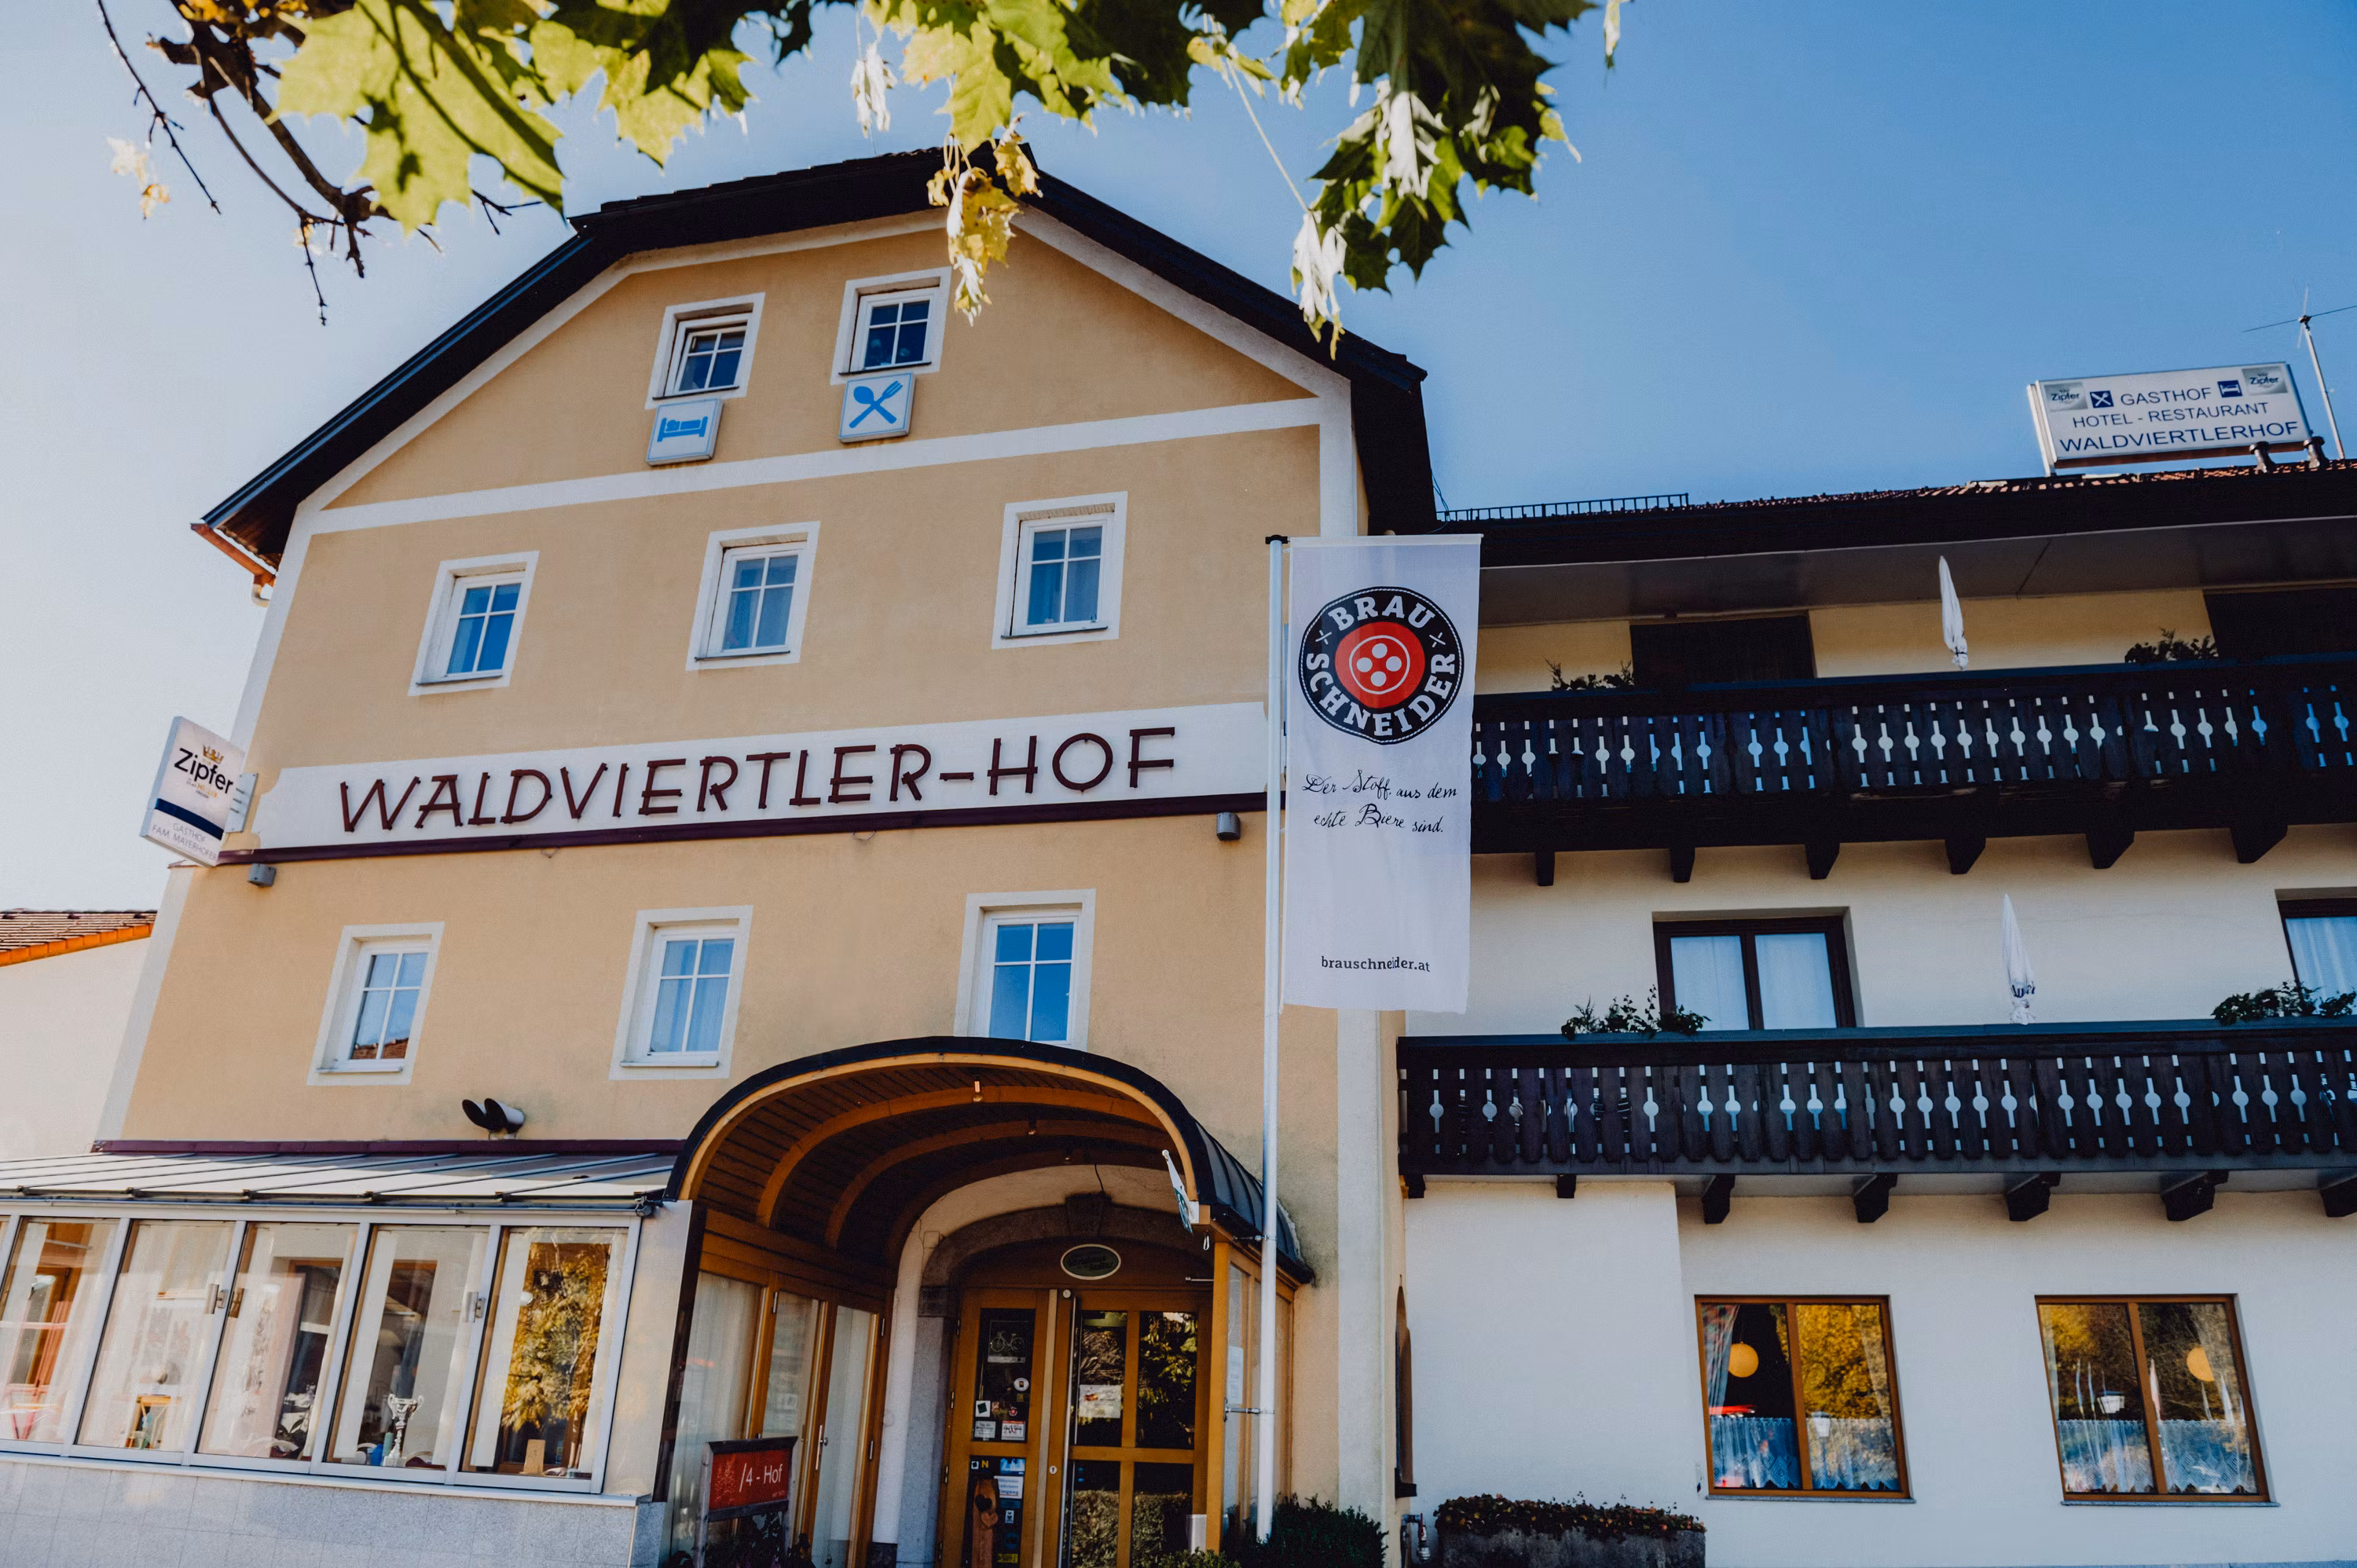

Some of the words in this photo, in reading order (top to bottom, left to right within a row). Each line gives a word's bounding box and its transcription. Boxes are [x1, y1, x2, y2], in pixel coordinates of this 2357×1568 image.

[2249, 376, 2279, 386] Zipfer
[2051, 393, 2080, 402] Zipfer
[2121, 387, 2212, 405] GASTHOF
[2073, 413, 2133, 428] HOTEL
[2148, 401, 2269, 423] RESTAURANT
[2059, 421, 2298, 452] WALDVIERTLERHOF
[1328, 595, 1436, 632] BRAU
[1306, 652, 1456, 737] SCHNEIDER
[174, 747, 234, 794] Zipfer
[339, 726, 1175, 833] WALDVIERTLER-HOF
[1301, 773, 1337, 794] Der
[1396, 789, 1421, 799] aus
[1427, 782, 1457, 799] dem
[1313, 810, 1349, 828] echte
[1354, 803, 1406, 829] Biere
[1412, 815, 1443, 833] sind.
[173, 822, 206, 843] GASTHOF
[1321, 955, 1431, 973] brauschneider.at
[764, 1464, 783, 1486] Hof
